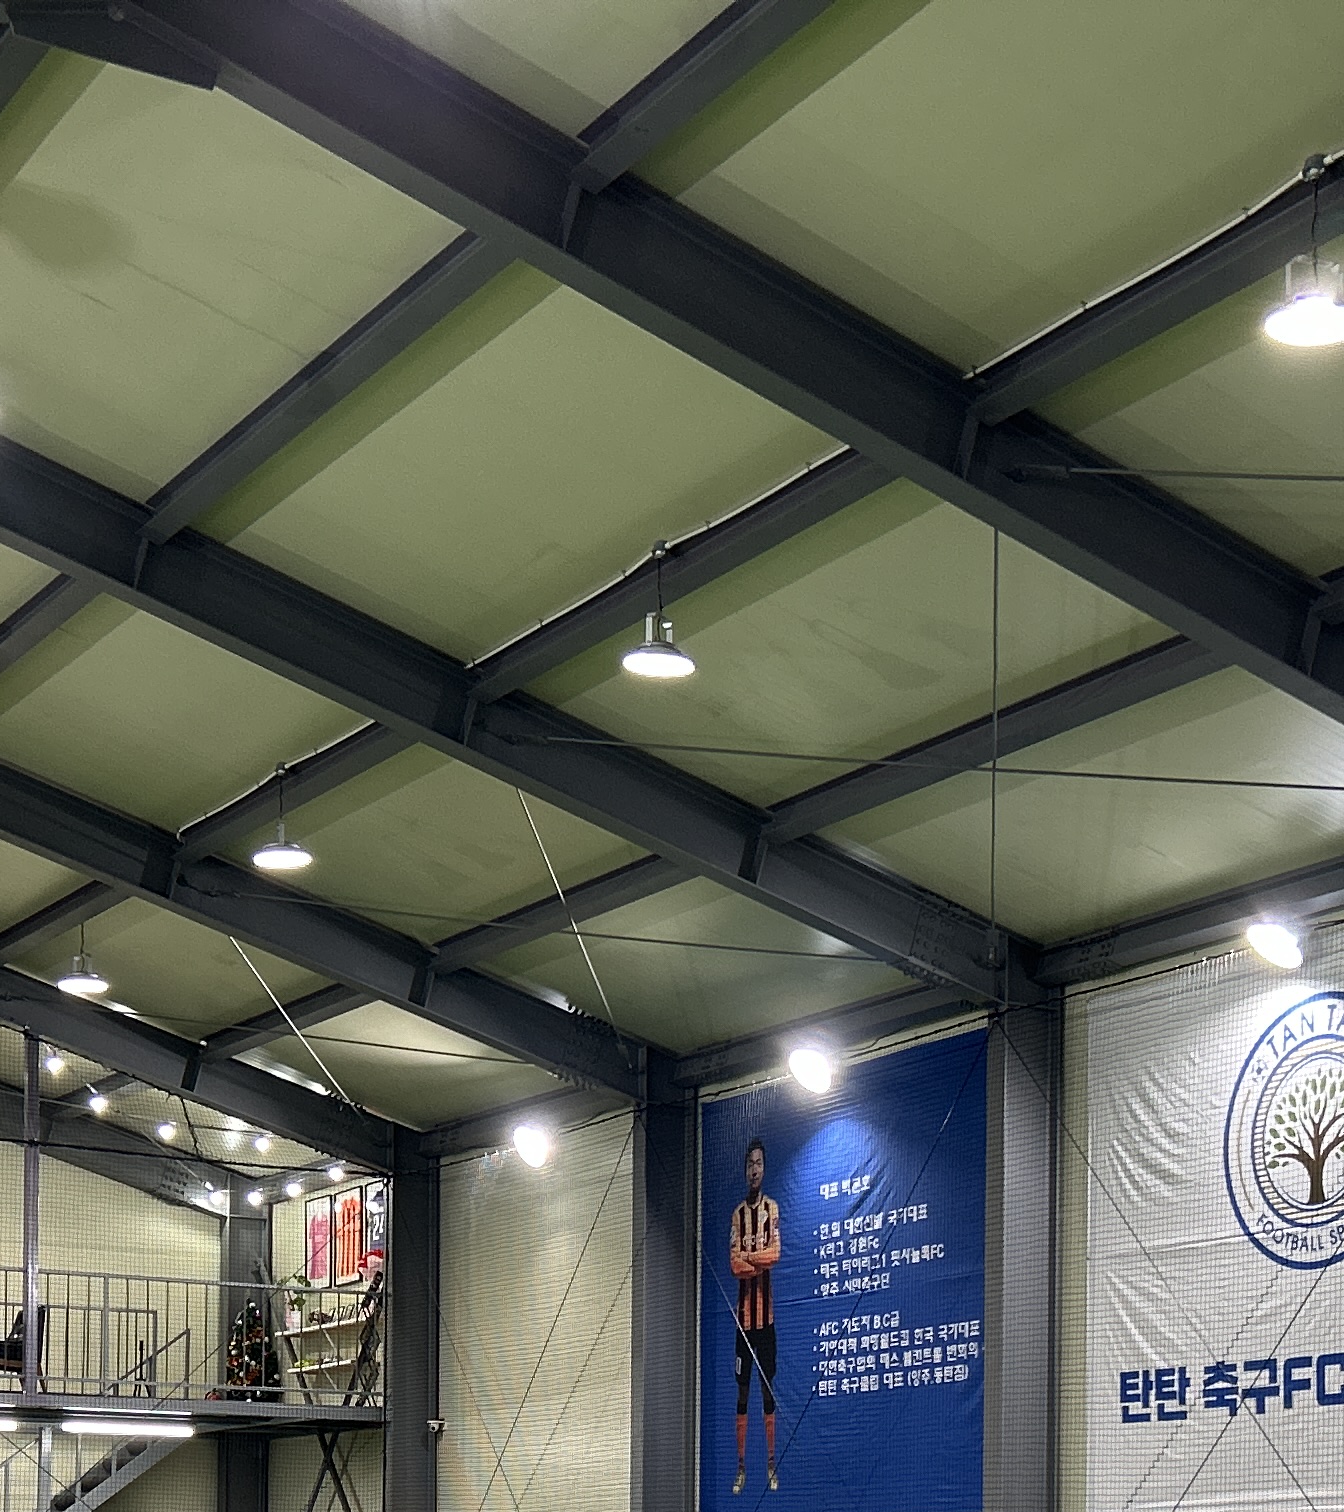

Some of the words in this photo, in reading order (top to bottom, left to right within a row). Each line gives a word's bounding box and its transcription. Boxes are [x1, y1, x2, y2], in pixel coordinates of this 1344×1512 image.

[1266, 1011, 1315, 1060] TAN
[1256, 1213, 1324, 1252] FOOTBALL
[819, 1320, 839, 1338] AFC
[1119, 1365, 1192, 1424] 탄탄
